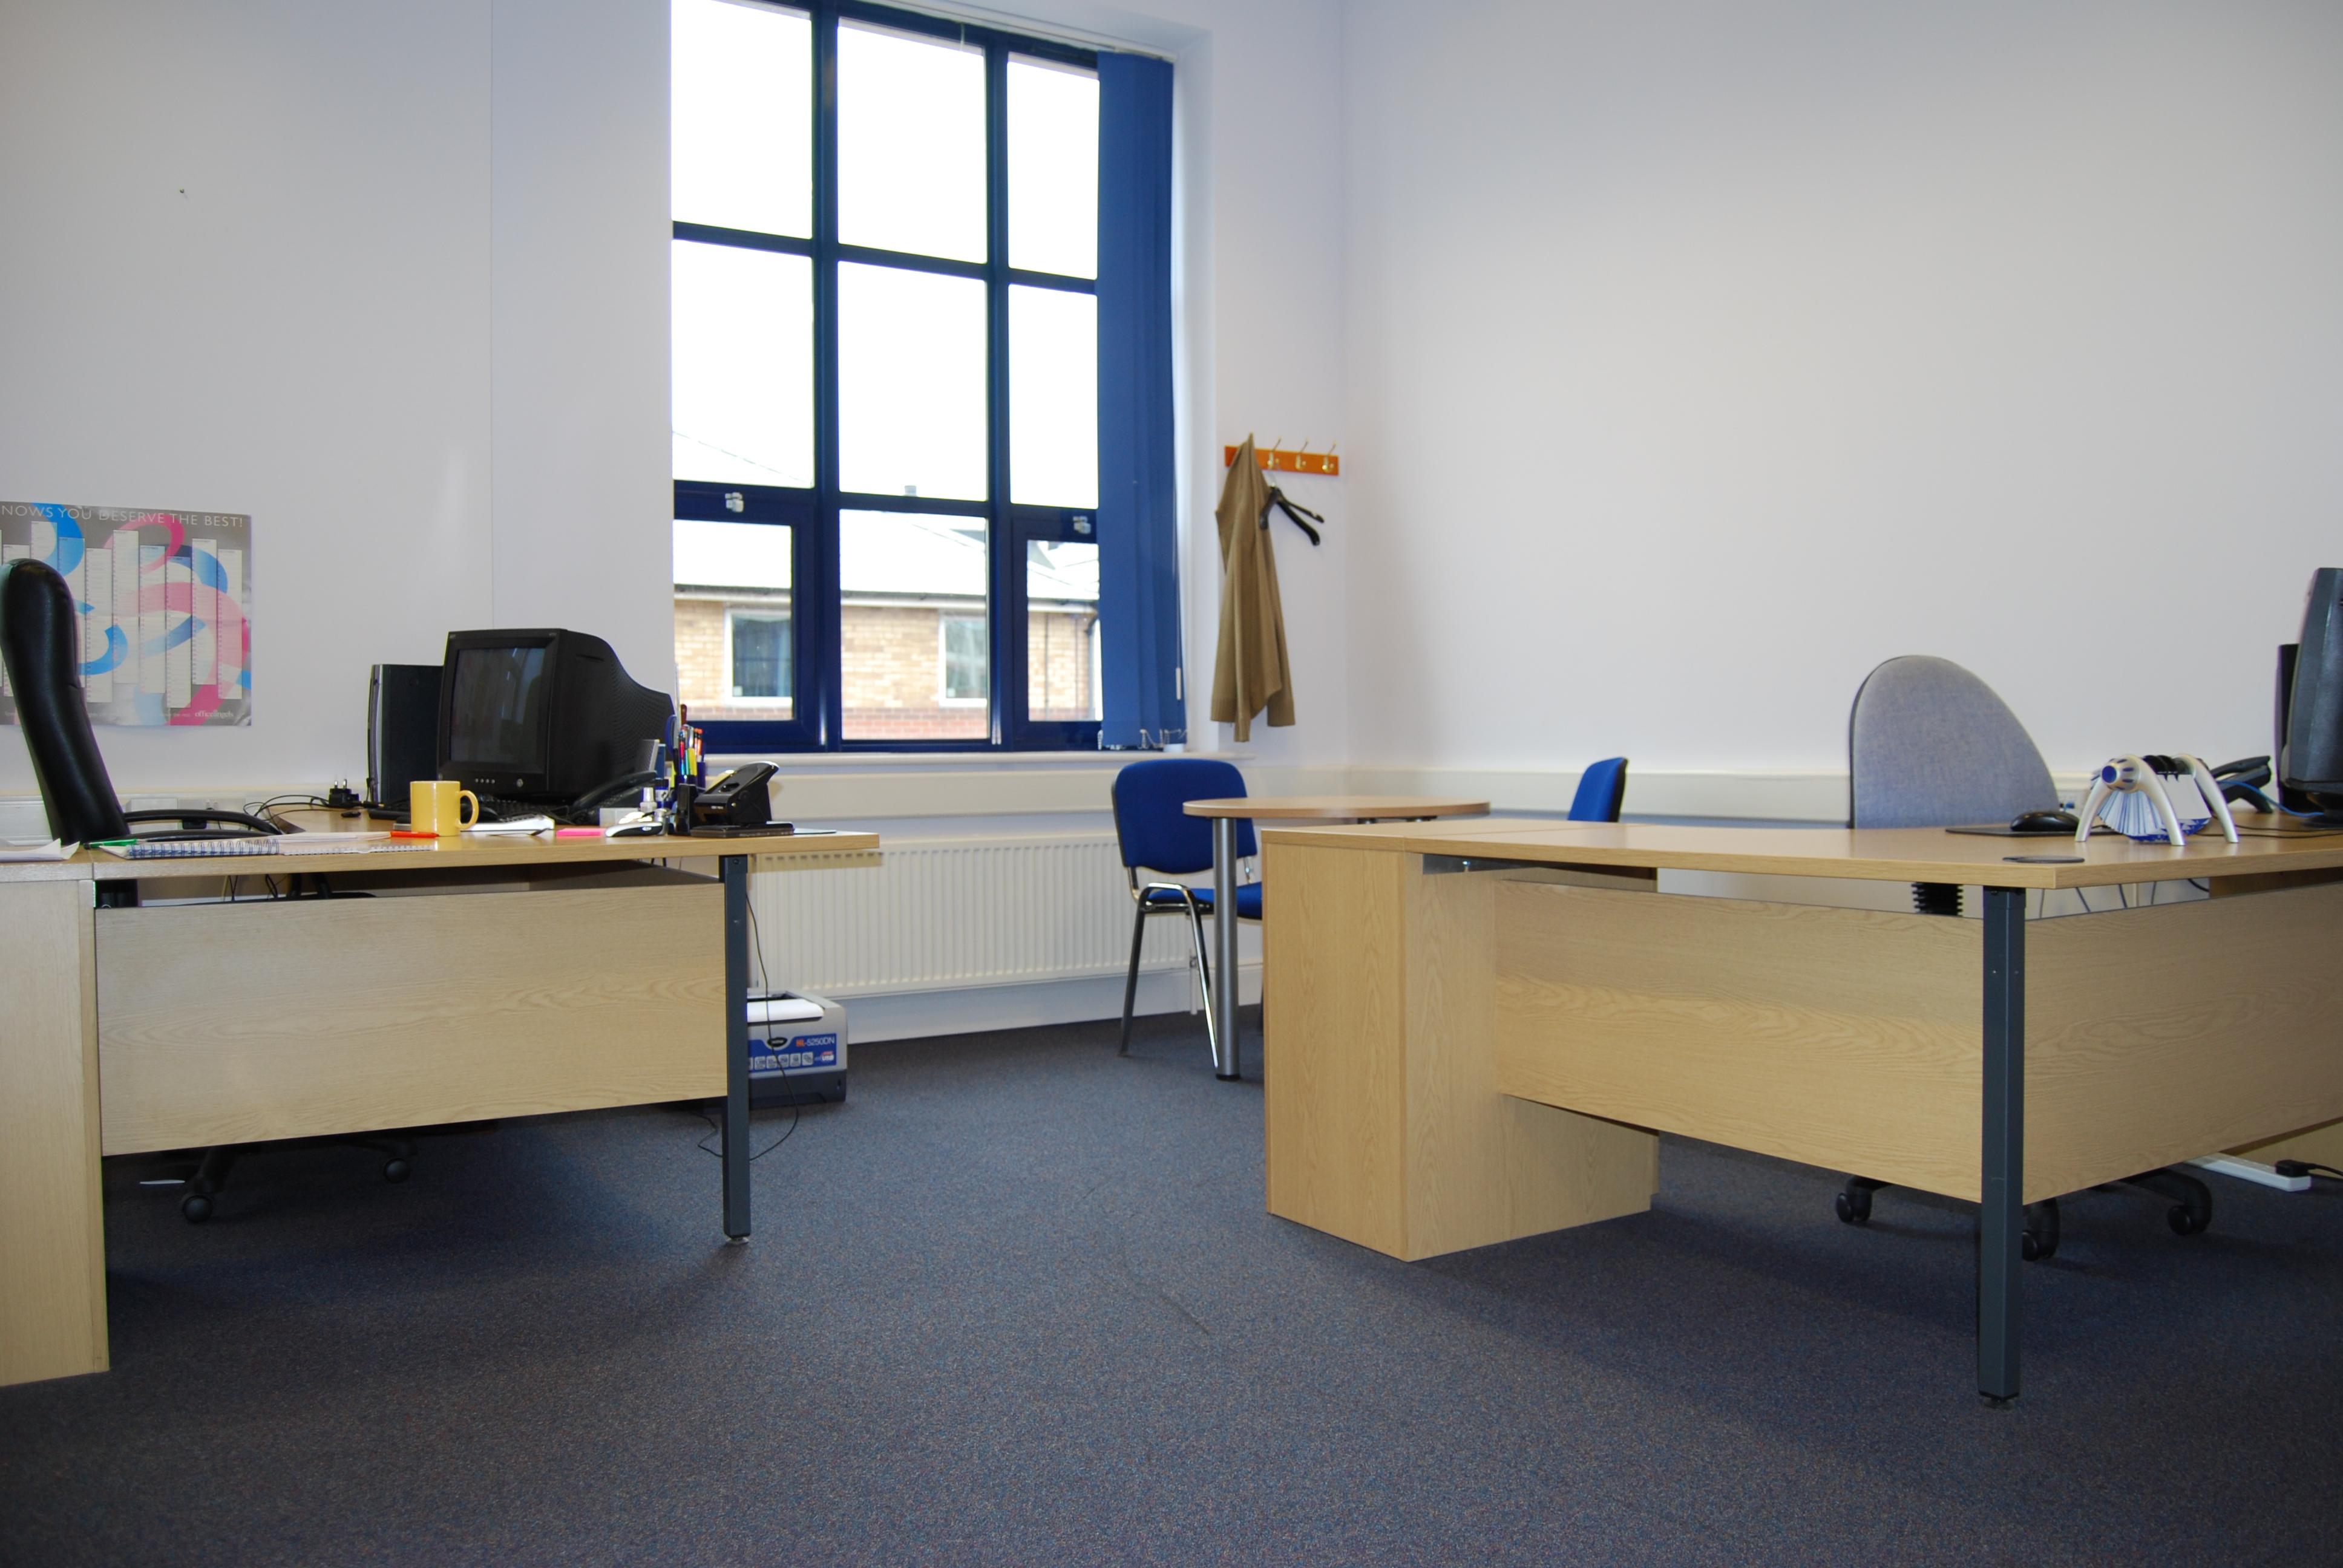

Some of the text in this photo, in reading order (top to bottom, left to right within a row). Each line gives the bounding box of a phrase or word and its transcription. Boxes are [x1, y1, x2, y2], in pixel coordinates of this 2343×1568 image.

[2, 505, 243, 528] NOWS YOU DESERVE THE BEST!
